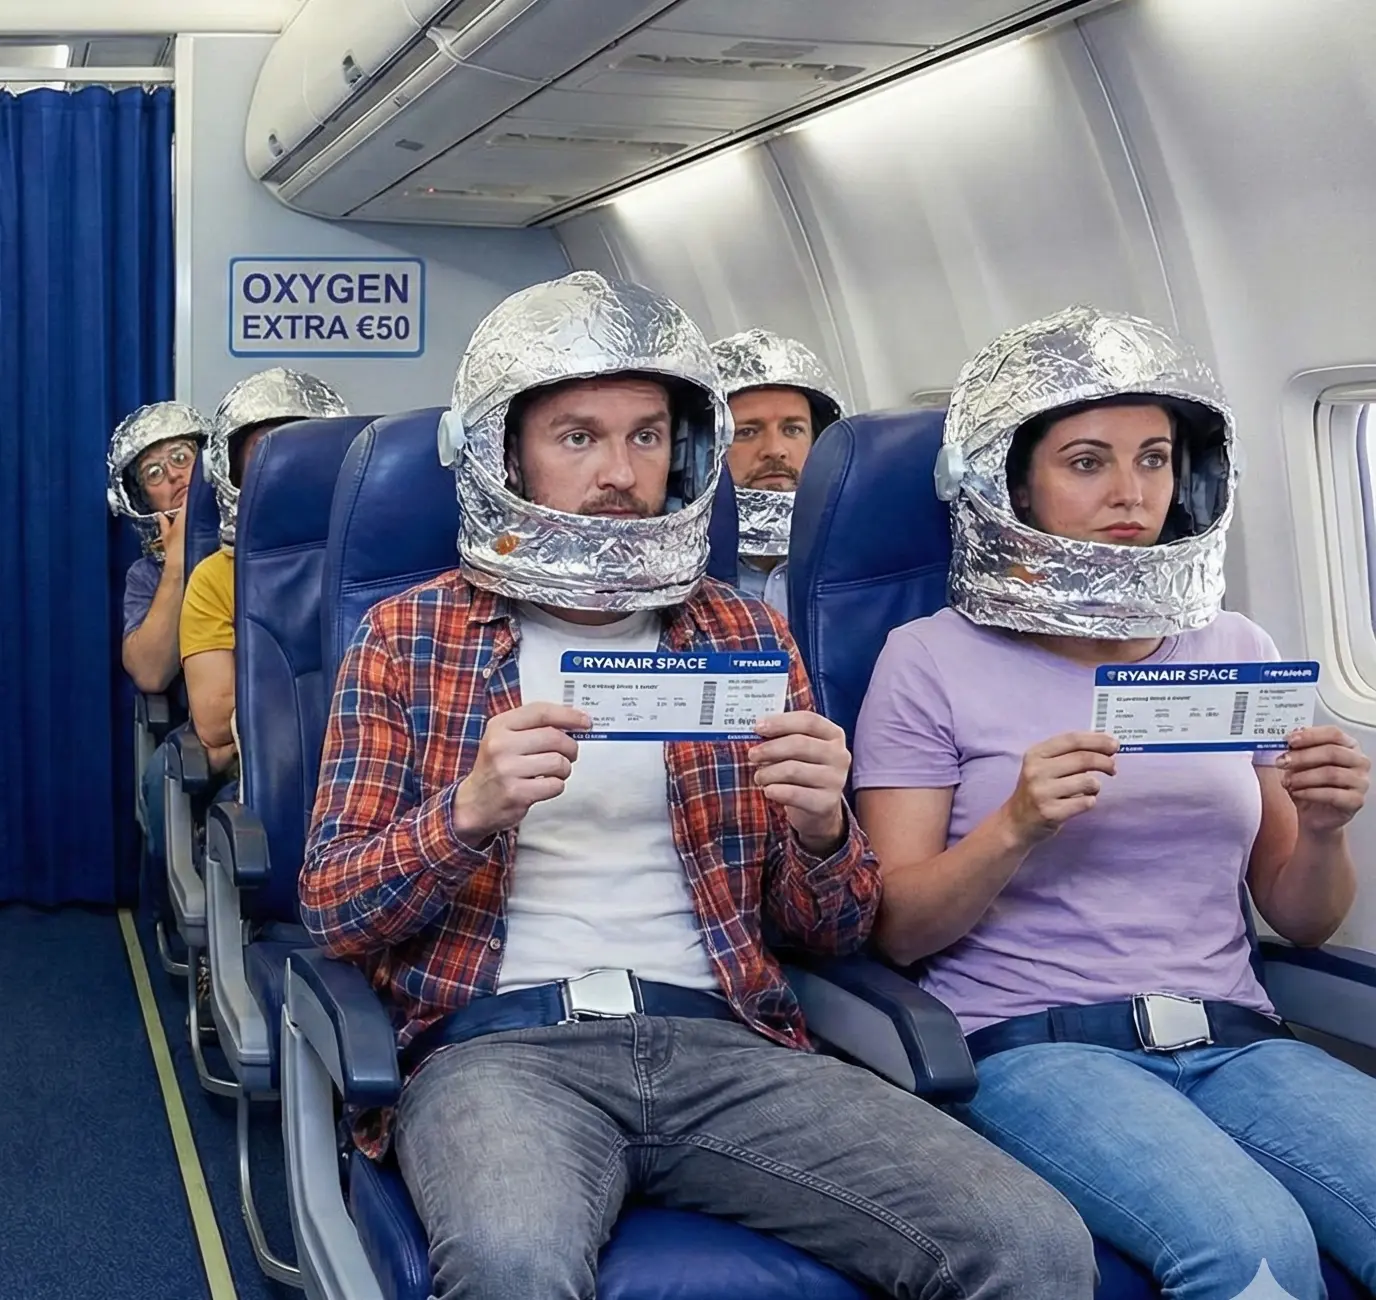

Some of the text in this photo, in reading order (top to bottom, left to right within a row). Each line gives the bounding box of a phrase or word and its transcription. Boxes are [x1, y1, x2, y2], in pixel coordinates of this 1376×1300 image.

[242, 273, 409, 304] OXYGEN
[242, 315, 410, 340] EXTRA €50
[583, 657, 708, 670] RYANAIR SPACE
[1117, 668, 1238, 681] RYANAIR SPACE
